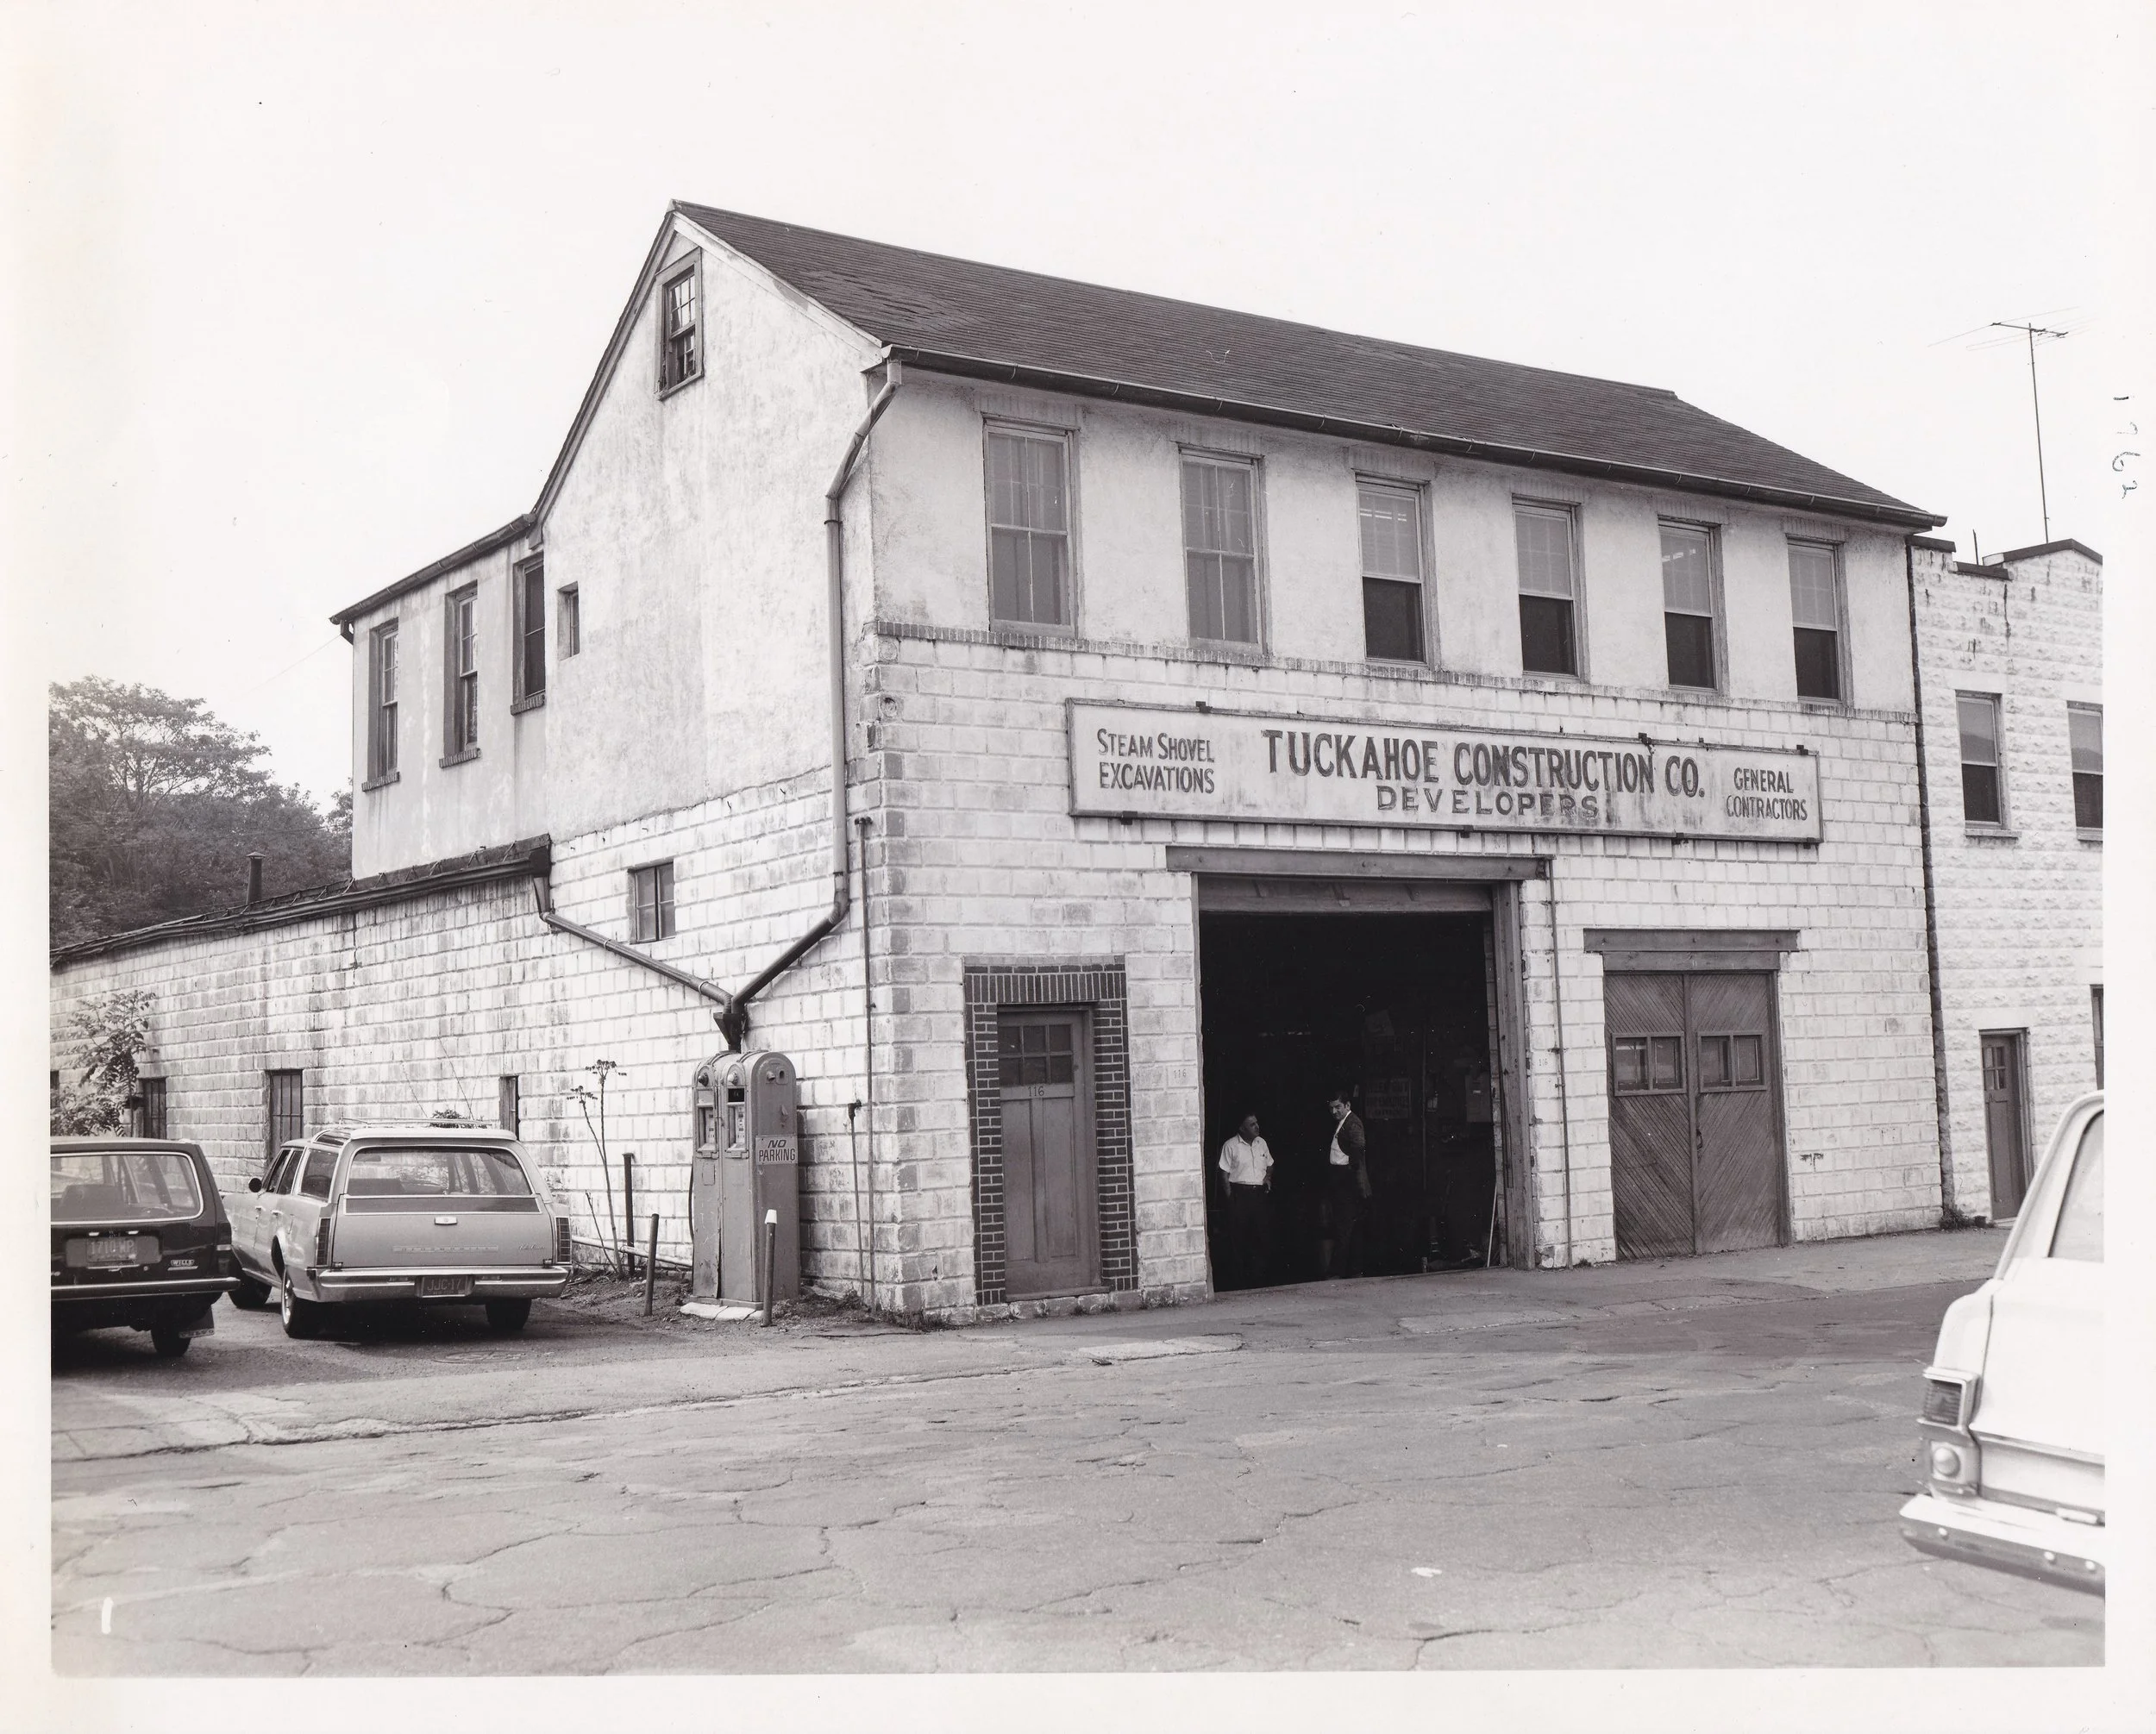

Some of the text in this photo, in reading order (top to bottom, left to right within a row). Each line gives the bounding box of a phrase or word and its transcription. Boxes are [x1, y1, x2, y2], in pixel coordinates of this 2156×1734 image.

[1099, 761, 1215, 795] EXCAVATIONS
[1260, 729, 1706, 798] TUCKAHOE CONSTRUCTION CO.
[1733, 767, 1795, 795] GENERAL
[1376, 784, 1600, 821] DEVELOPERS
[1727, 793, 1808, 823] CONTRACTORS
[1028, 1086, 1044, 1097] 116
[758, 1149, 796, 1162] PARKING
[767, 1139, 787, 1149] NO
